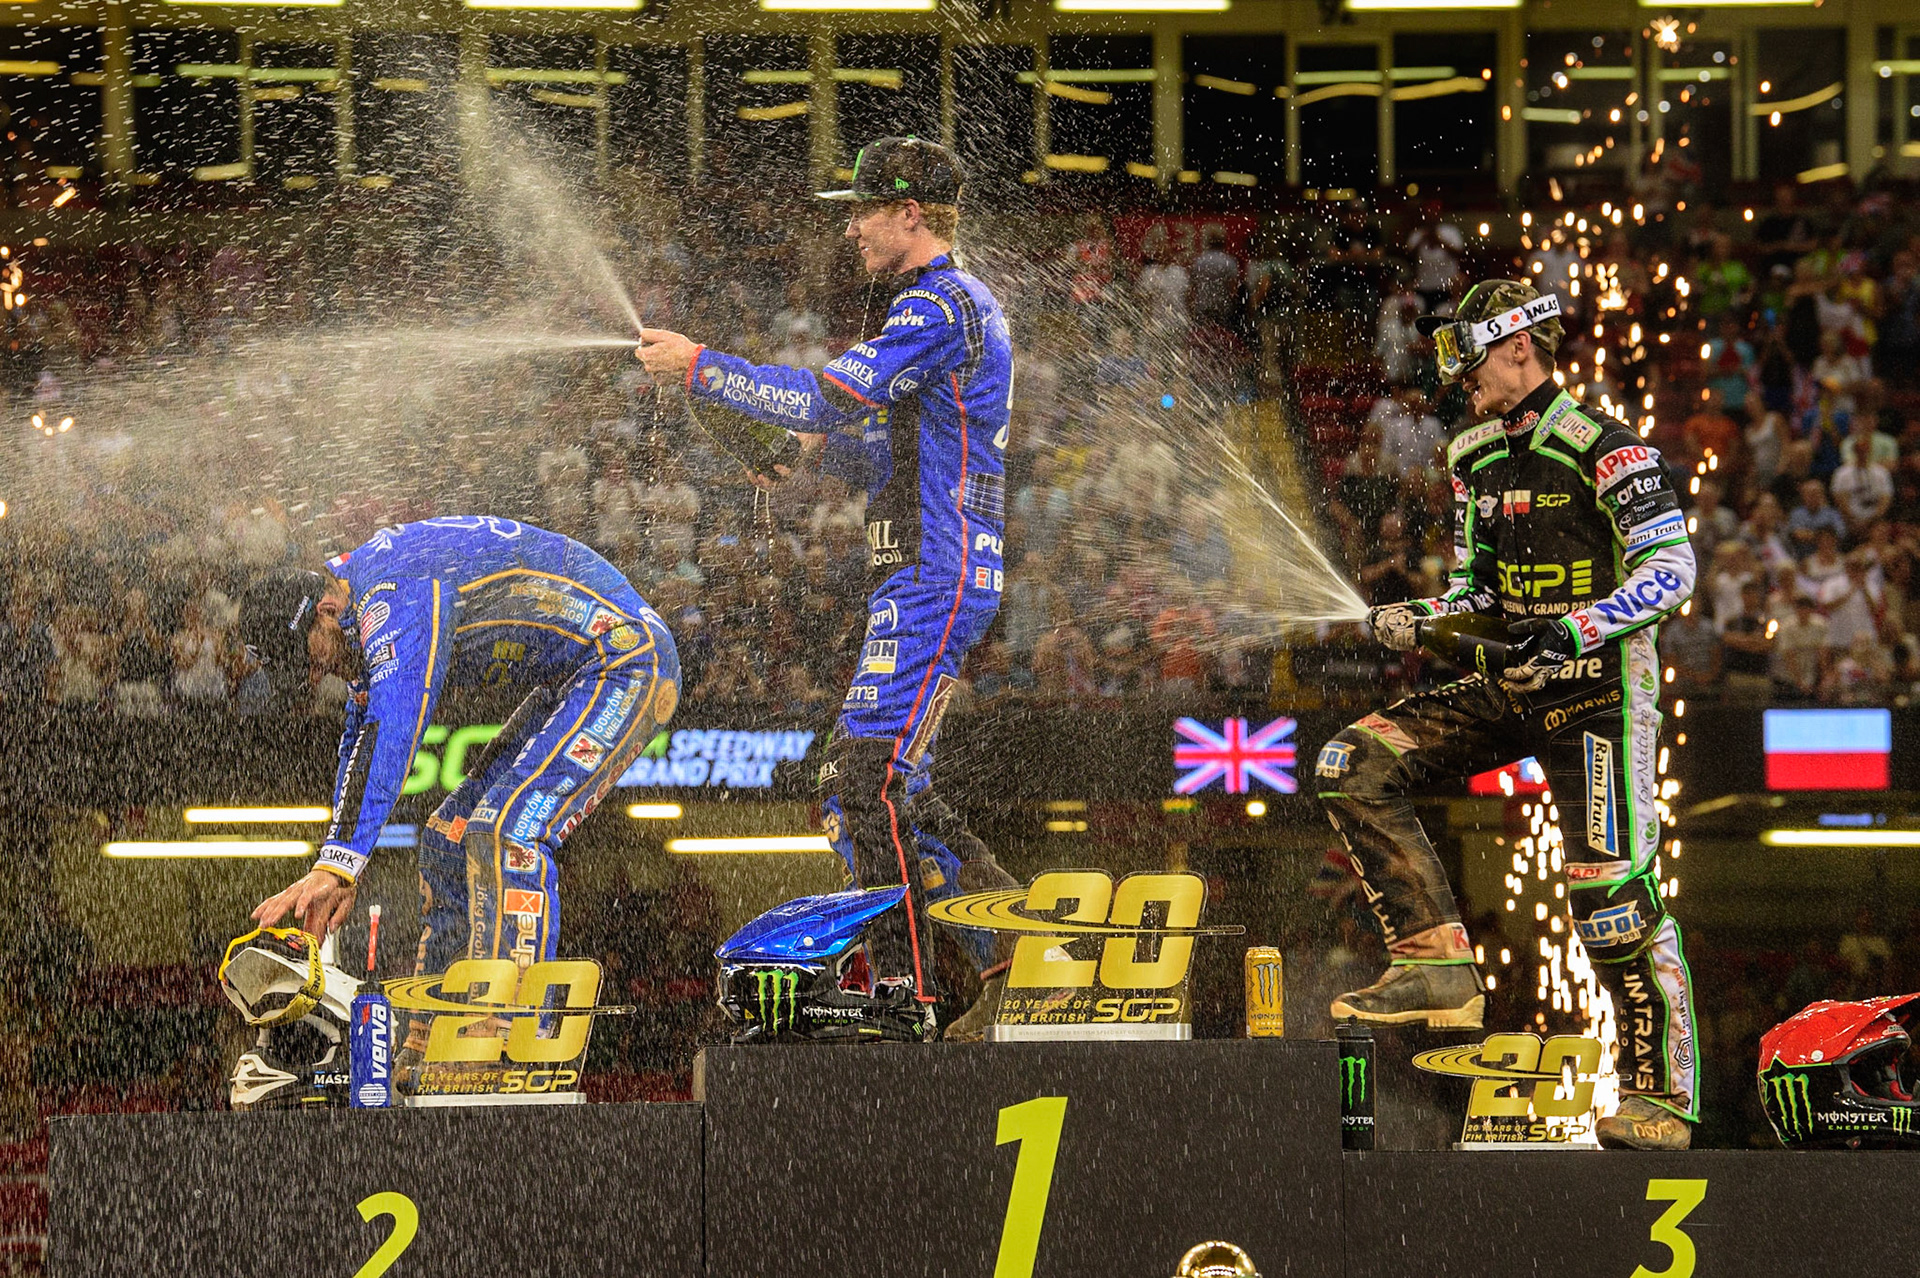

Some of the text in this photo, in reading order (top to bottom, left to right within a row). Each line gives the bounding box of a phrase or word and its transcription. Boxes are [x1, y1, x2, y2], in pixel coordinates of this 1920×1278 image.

[722, 386, 810, 420] KONSTRUKCJE
[726, 372, 812, 408] KRAJEWSKI
[1539, 399, 1573, 437] MARWIS
[1453, 424, 1502, 455] UMEL
[1535, 493, 1571, 508] SGP
[1605, 474, 1662, 513] Bartex
[1633, 500, 1656, 514] Toyota
[1654, 522, 1683, 536] Truck
[1533, 603, 1569, 616] GRAND
[1595, 570, 1681, 625] Nice
[867, 641, 896, 657] ON
[1558, 658, 1603, 679] are
[593, 687, 625, 733] GORZÓW
[1566, 690, 1620, 717] MARWIS
[669, 729, 815, 761] SPEEDWAY
[1592, 741, 1607, 843] Rami Truck
[514, 791, 544, 838] GORZÓW
[473, 883, 488, 918] Jörg
[1007, 873, 1203, 988] 20
[1620, 932, 1640, 943] 1991
[424, 959, 601, 1062] 20
[802, 1006, 864, 1018] MONSTER
[1000, 998, 1180, 1023] FIM BRITISH SGP
[1003, 999, 1091, 1010] 20 YEARS OF
[371, 1003, 388, 1079] verva
[313, 1074, 351, 1085] MASZ
[417, 1070, 578, 1093] FIM BRITISH SGP
[439, 1073, 478, 1081] YEARS
[482, 1072, 499, 1081] OF
[1469, 1035, 1602, 1117] 20
[1817, 1111, 1888, 1125] MONSTER
[996, 1096, 1069, 1278] 1
[352, 1191, 419, 1278] 2
[1629, 1179, 1709, 1278] 3
